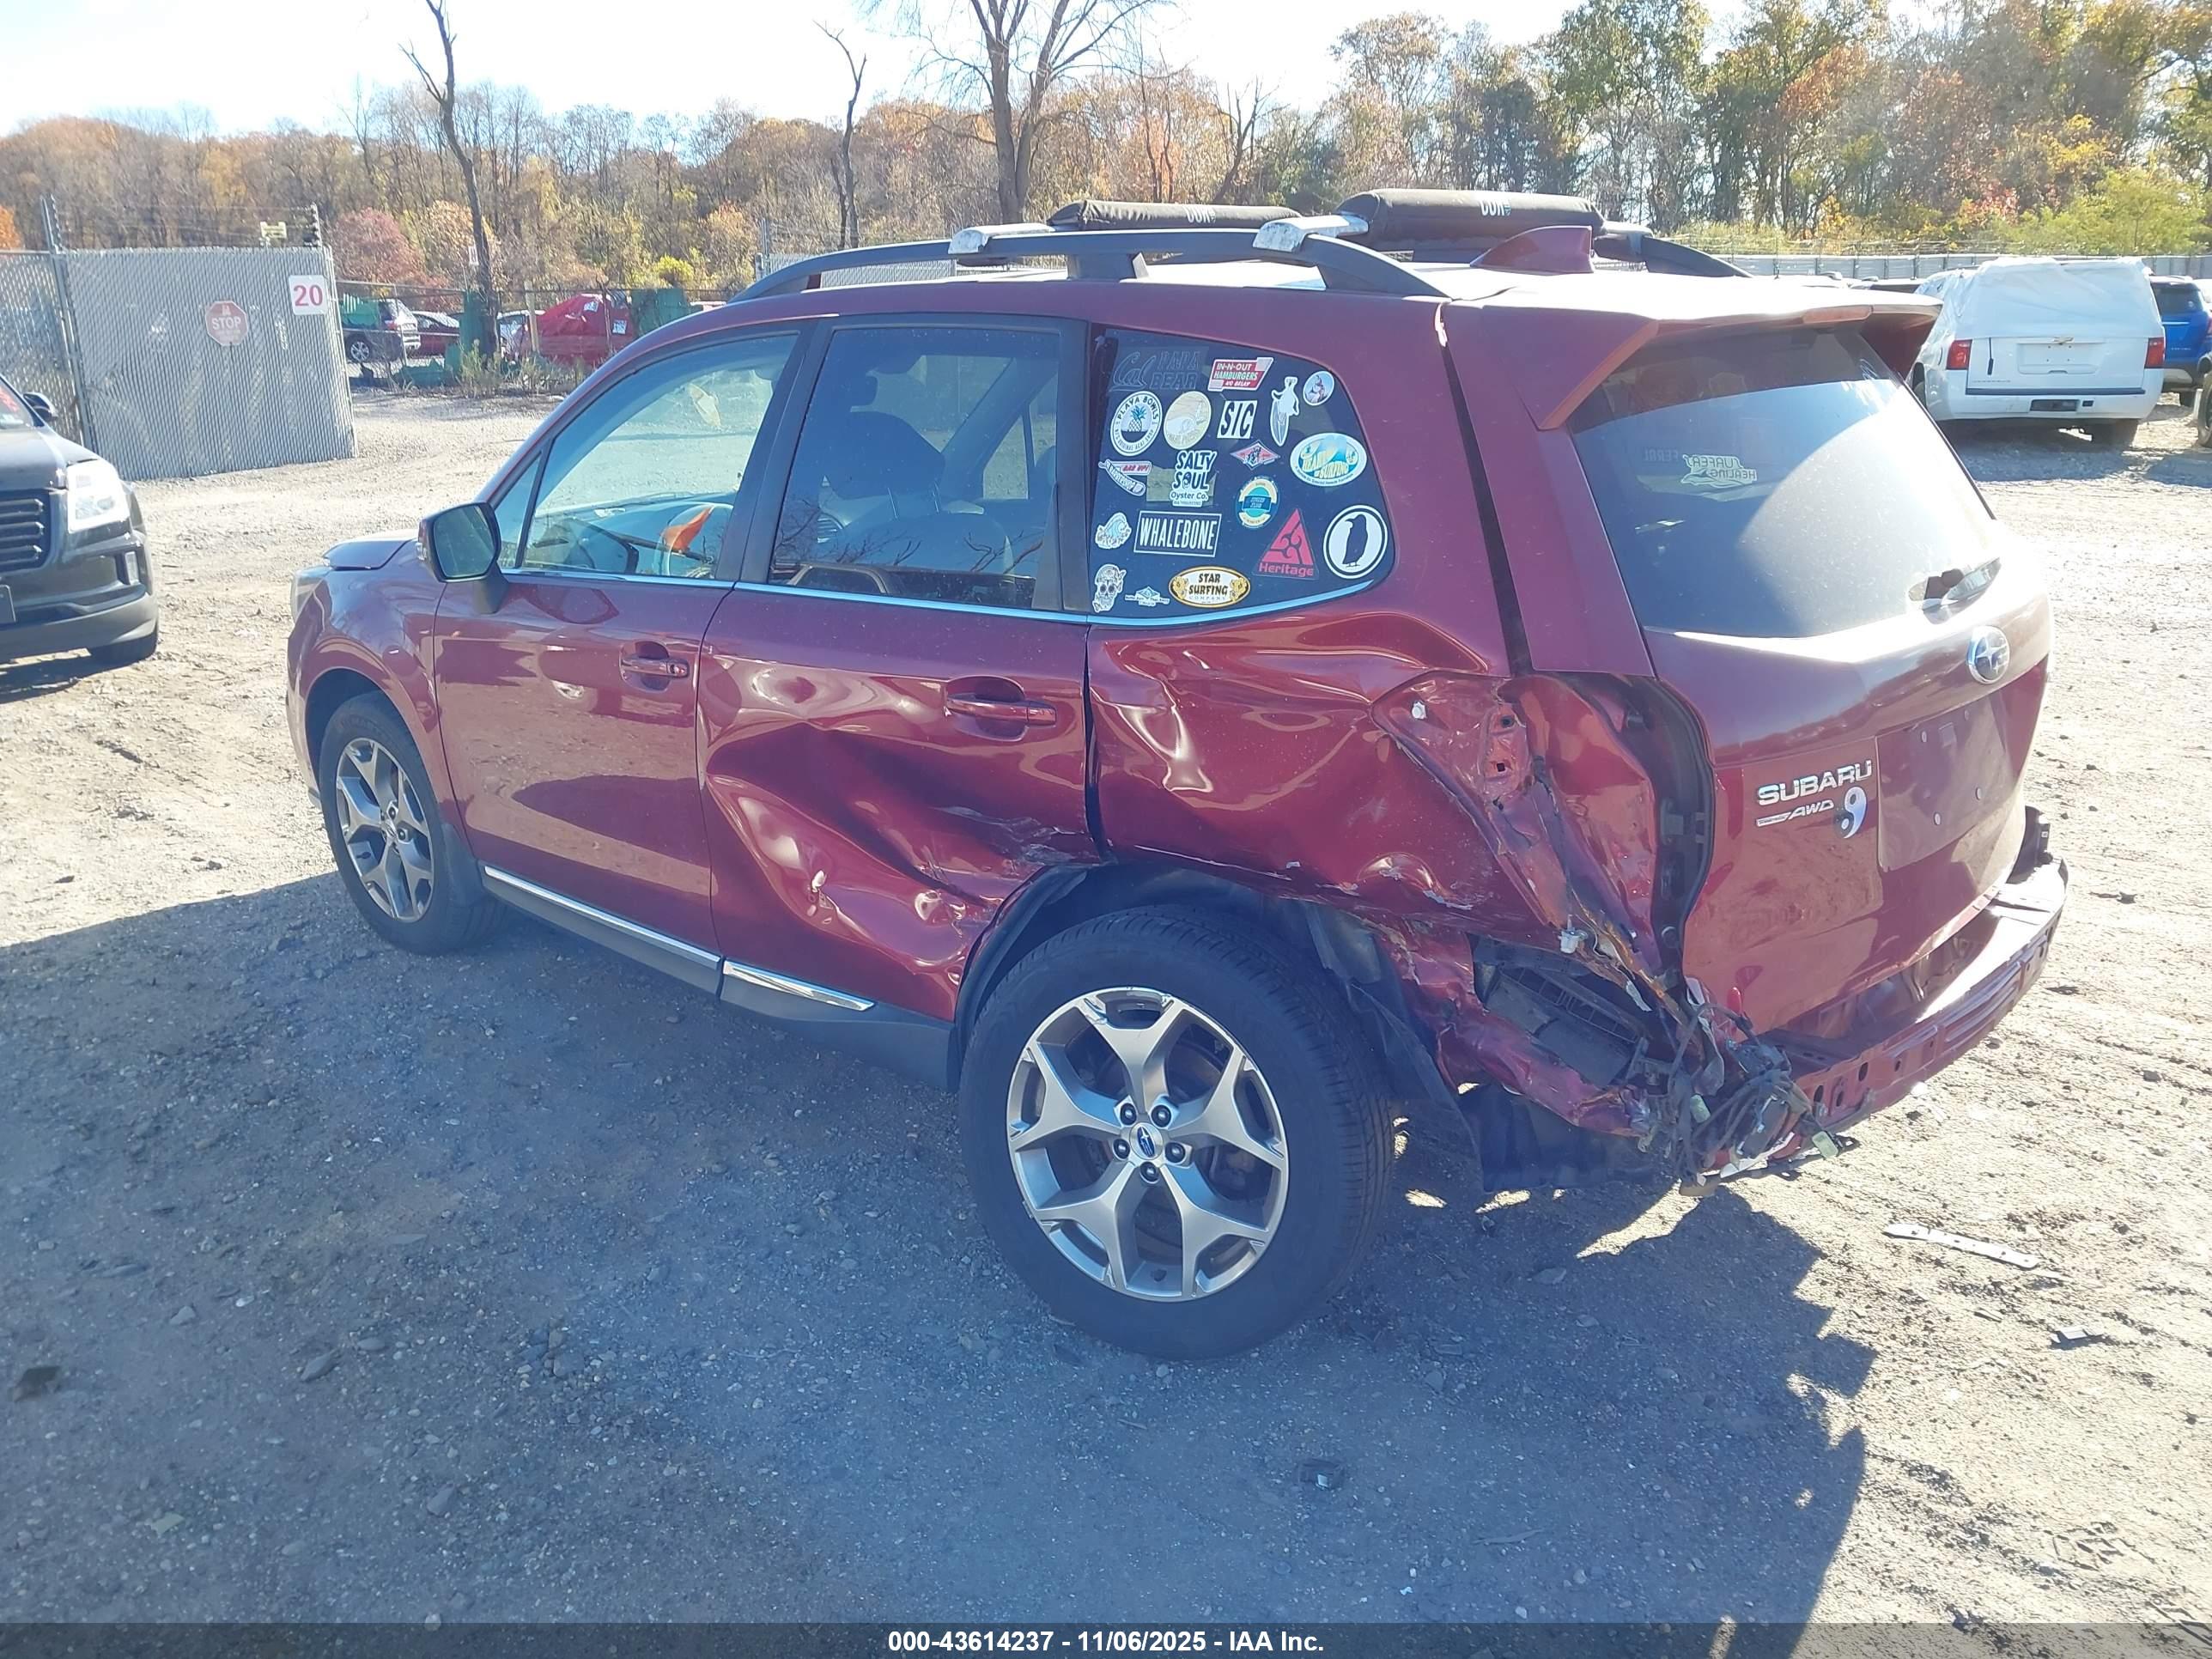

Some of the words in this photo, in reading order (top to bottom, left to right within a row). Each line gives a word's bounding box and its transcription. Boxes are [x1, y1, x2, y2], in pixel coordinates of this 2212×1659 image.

[293, 284, 323, 307] 20
[211, 316, 241, 330] STOP
[1213, 370, 1259, 380] HAMBURGERS
[1216, 362, 1253, 371] IN-N-OUT
[1149, 372, 1198, 390] BEAR
[1117, 397, 1139, 420] PLAYA
[1143, 396, 1159, 420] BOWLS
[1220, 402, 1255, 437] SIC
[1176, 452, 1217, 470] SALTY
[1173, 471, 1209, 489] SOUL
[1139, 518, 1218, 550] WHALEBONE
[1198, 573, 1220, 583] STAR
[1259, 562, 1314, 577] Heritage
[1188, 585, 1229, 595] SURFING
[1758, 760, 1872, 806] SUBARU
[1789, 799, 1834, 820] AWD
